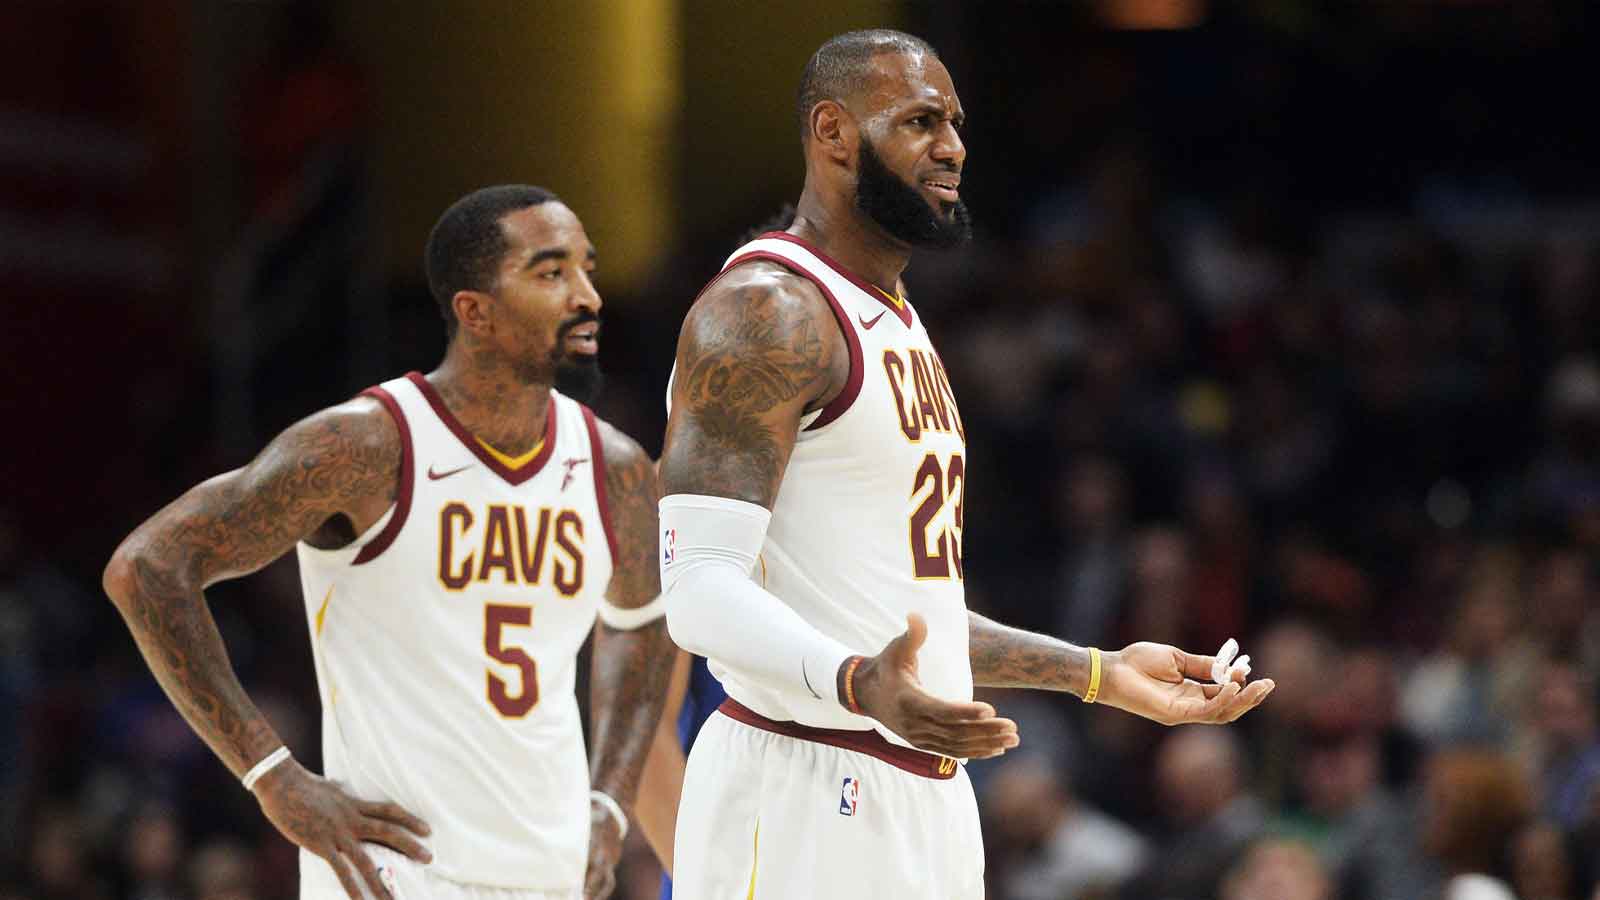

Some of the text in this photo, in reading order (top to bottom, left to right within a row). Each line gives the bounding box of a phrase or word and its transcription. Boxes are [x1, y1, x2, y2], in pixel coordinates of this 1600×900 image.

[437, 499, 585, 598] CAVS
[909, 451, 963, 581] 23
[482, 601, 540, 720] 5
